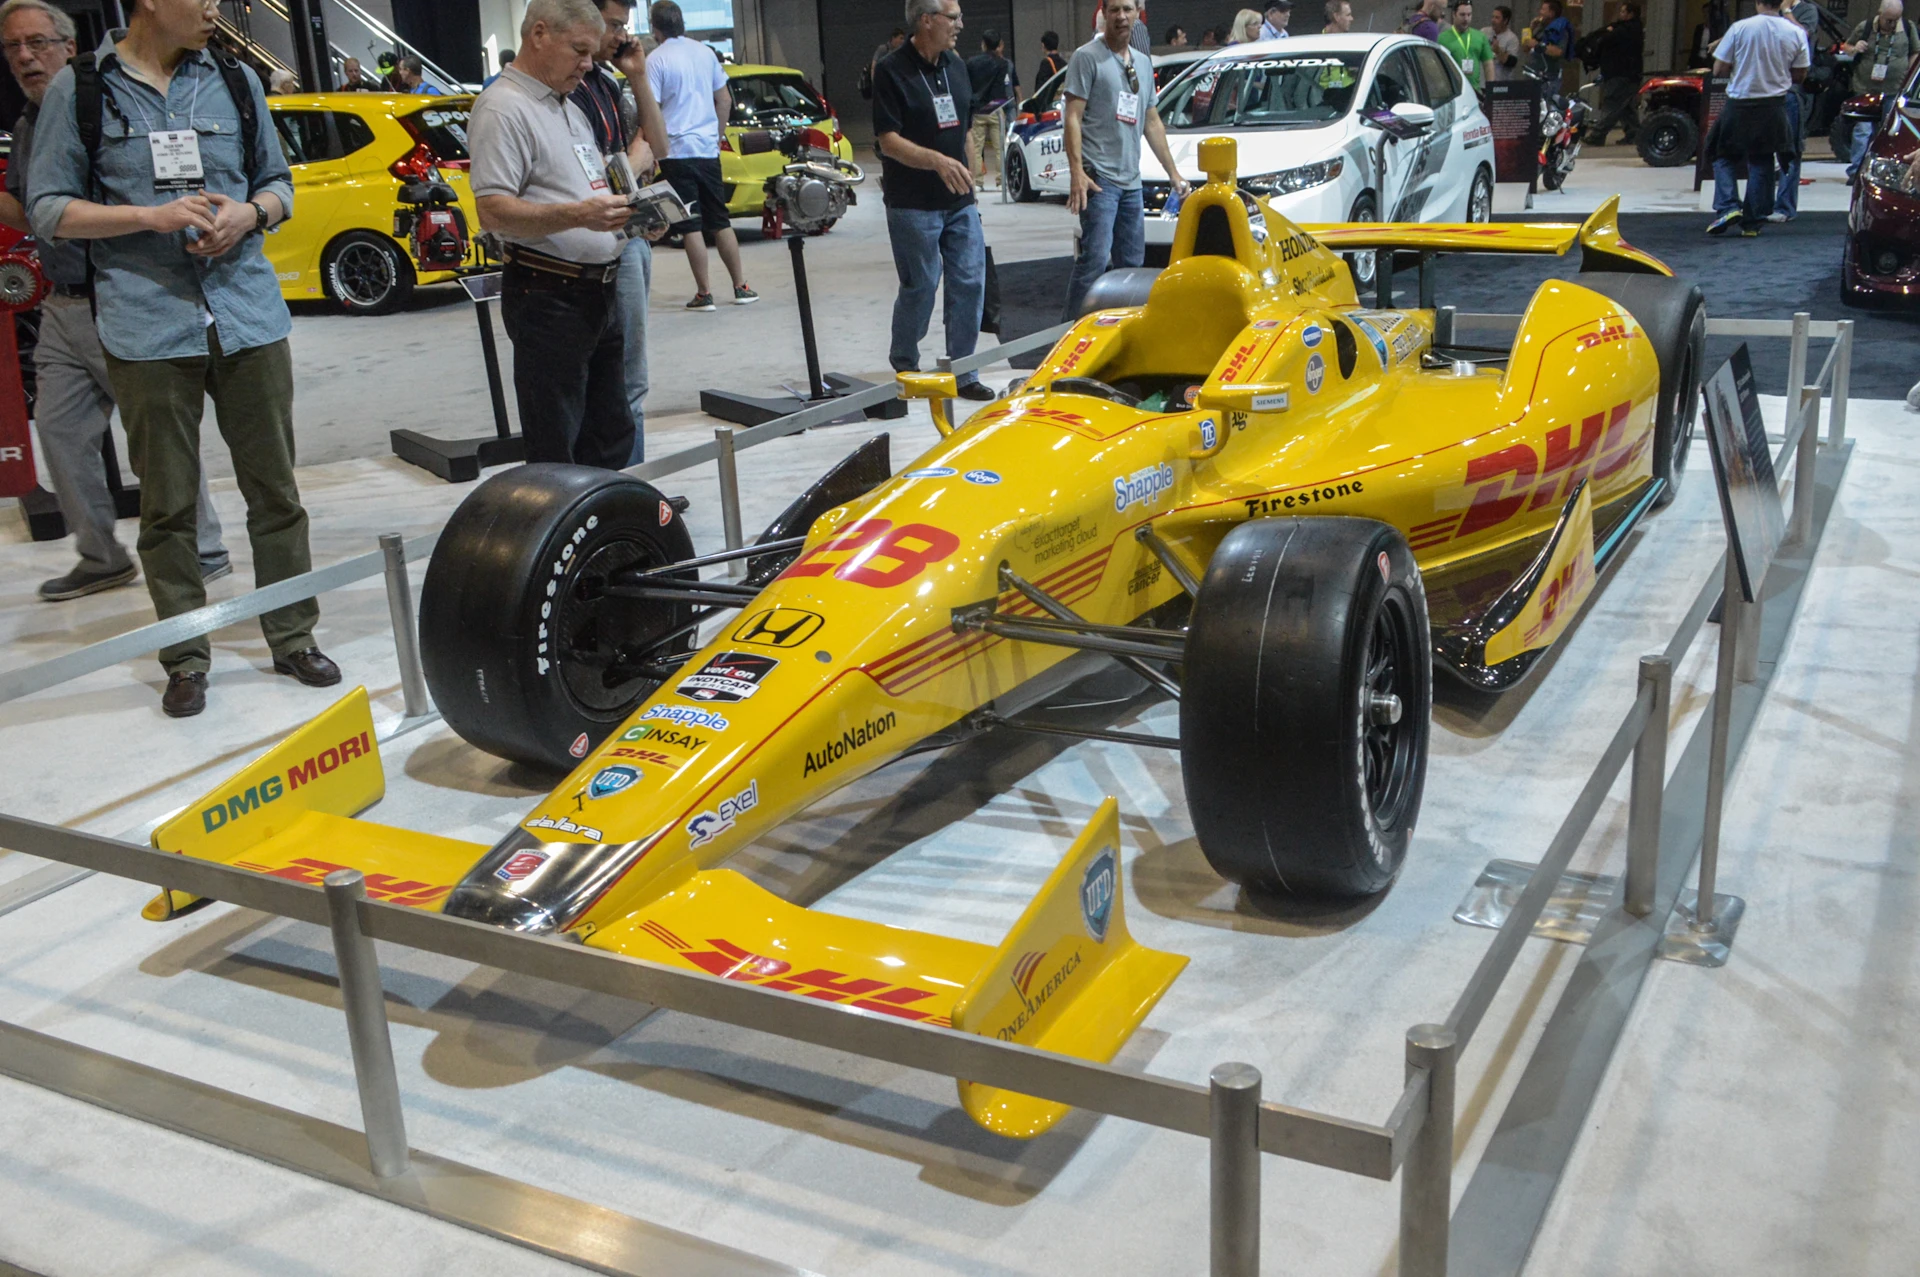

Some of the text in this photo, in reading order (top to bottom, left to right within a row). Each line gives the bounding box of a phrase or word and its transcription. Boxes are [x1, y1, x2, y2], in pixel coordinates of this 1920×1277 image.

[1233, 58, 1345, 70] HONDA
[1279, 232, 1319, 262] HONDA
[329, 262, 347, 301] YOKOHAMA
[1577, 325, 1632, 348] DHL
[1218, 343, 1257, 382] DHL
[1256, 397, 1285, 406] SIEMENS
[967, 471, 999, 483] Kroger
[1115, 463, 1173, 511] Snapple
[1454, 400, 1632, 538] DHL
[1245, 481, 1364, 517] Firestone
[774, 518, 960, 588] 28
[1034, 523, 1098, 565] marketing cloud
[536, 514, 598, 675] Firestone
[1539, 550, 1587, 636] DHL
[688, 676, 752, 690] INDYCAR
[694, 682, 736, 692] SERIES
[704, 666, 756, 680] verizon
[640, 704, 728, 730] Snapple
[609, 747, 671, 765] DHL
[803, 711, 896, 778] AutoNation
[201, 731, 371, 834] DMG MORI
[596, 771, 631, 789] UFD
[526, 814, 603, 842] dallara
[1086, 868, 1112, 916] UFD
[679, 939, 940, 1021] DHL
[996, 951, 1083, 1042] ONEAMERICA
